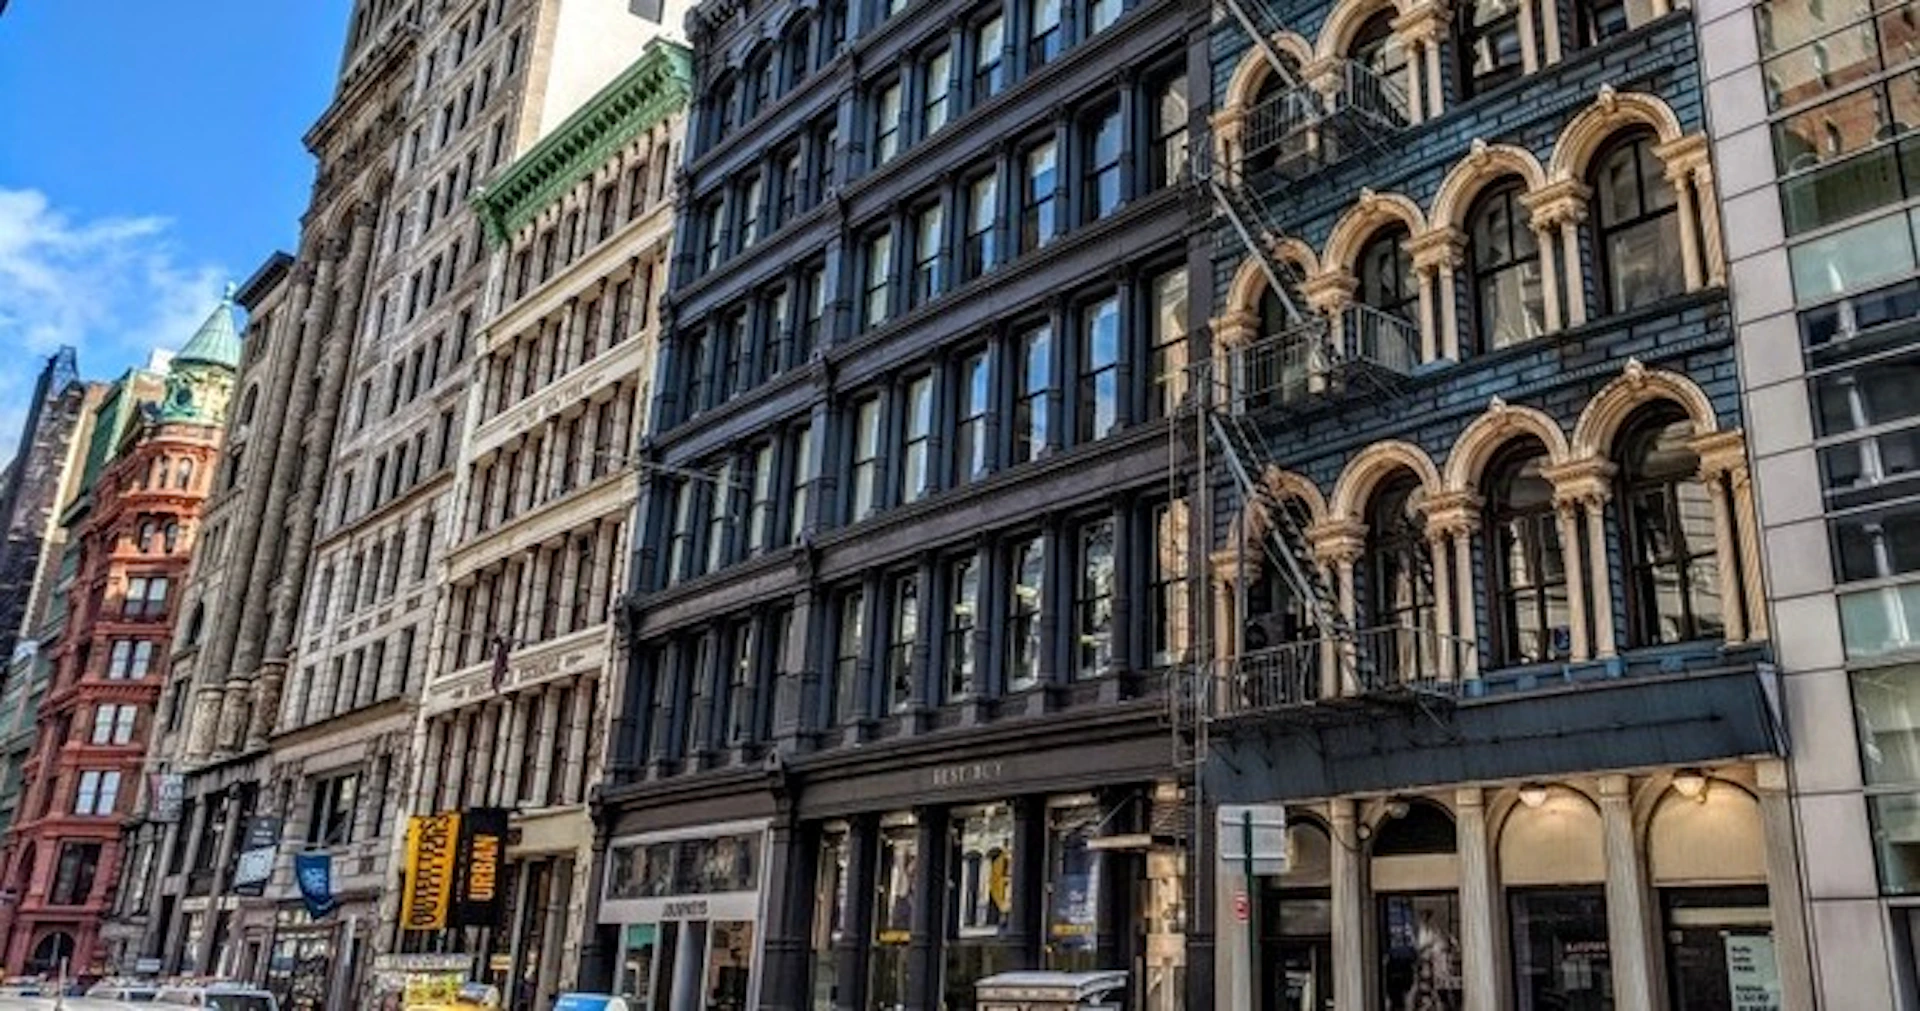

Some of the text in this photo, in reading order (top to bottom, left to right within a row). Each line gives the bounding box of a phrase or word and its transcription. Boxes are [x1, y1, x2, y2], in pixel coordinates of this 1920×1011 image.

[933, 764, 967, 786] BEST
[411, 815, 449, 926] OUTFITTERS
[468, 834, 500, 902] URBAN
